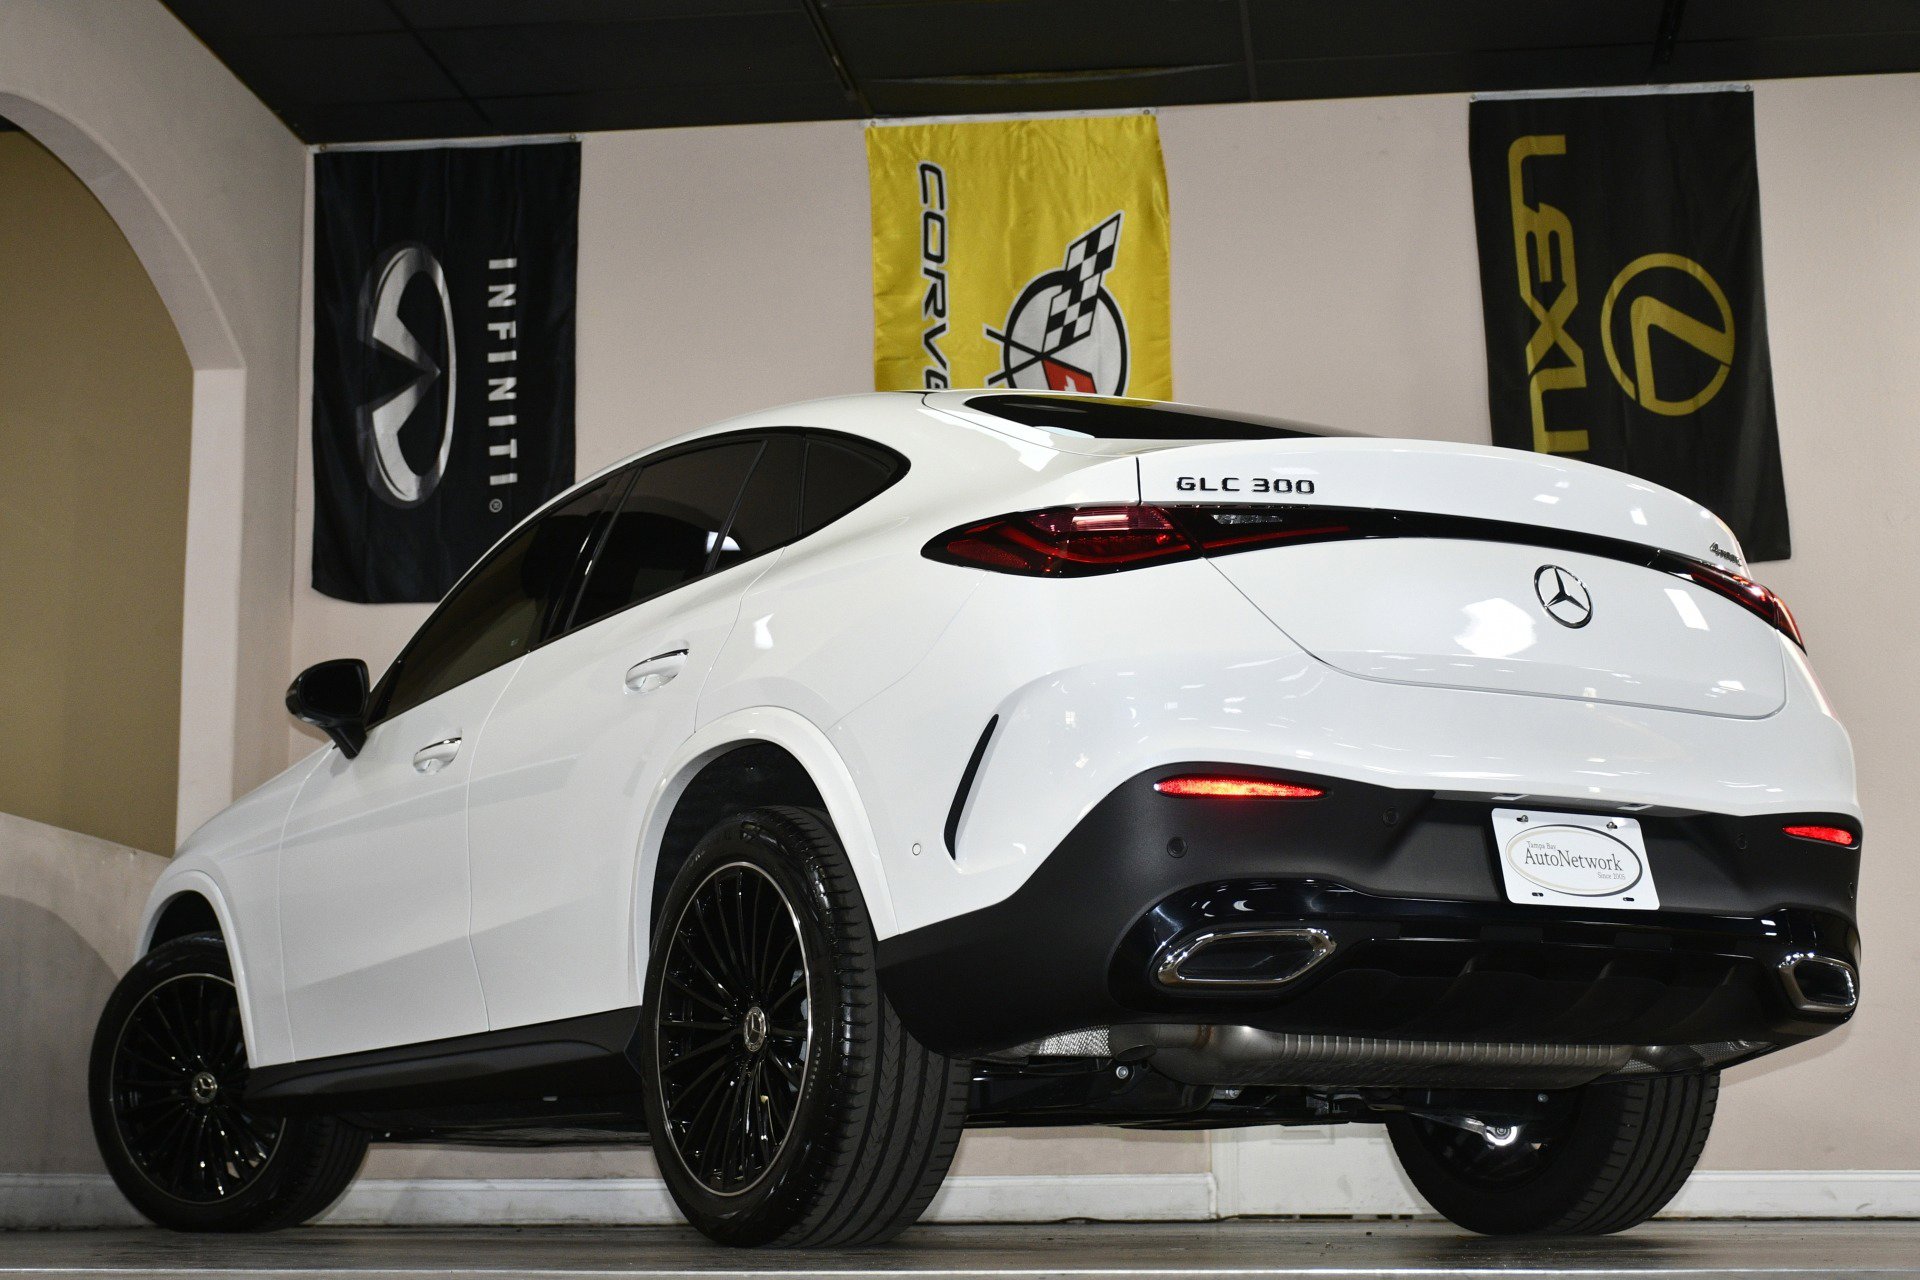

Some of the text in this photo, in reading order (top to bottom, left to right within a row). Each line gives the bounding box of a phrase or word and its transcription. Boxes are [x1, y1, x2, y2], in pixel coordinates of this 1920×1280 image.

[488, 257, 518, 486] INFINITI
[1176, 476, 1315, 494] GLC 300
[1526, 841, 1557, 850] Tampa Bay
[1525, 847, 1624, 871] AutoNetwork
[1597, 872, 1611, 880] Since
